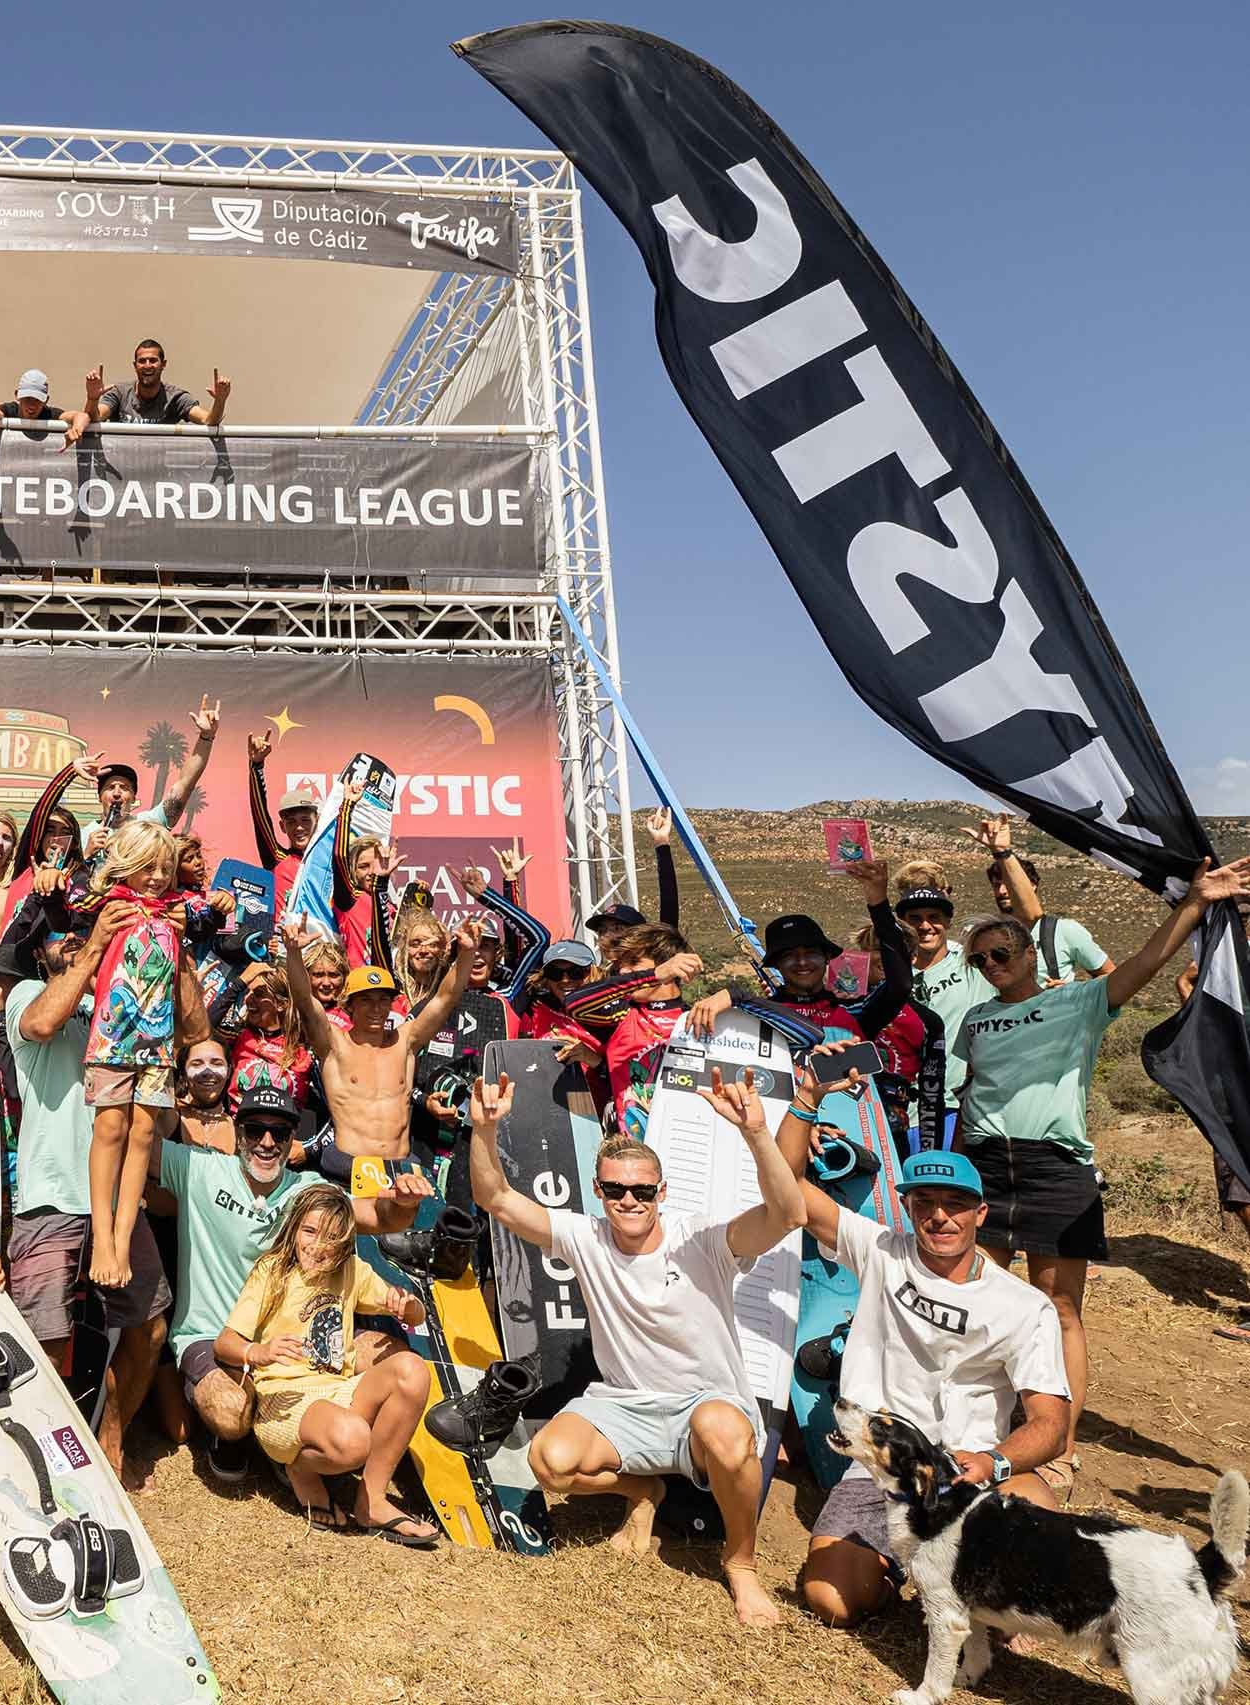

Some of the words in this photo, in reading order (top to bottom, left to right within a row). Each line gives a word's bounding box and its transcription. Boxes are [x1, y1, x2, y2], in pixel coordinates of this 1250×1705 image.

[55, 190, 175, 222] SOUTH
[273, 200, 387, 227] Diputación
[274, 229, 301, 247] de
[309, 228, 368, 251] Cádiz
[397, 211, 501, 260] Tarifa
[334, 486, 524, 527] LEAGUE
[332, 774, 523, 817] YSTIC
[62, 1431, 85, 1463] QATAR
